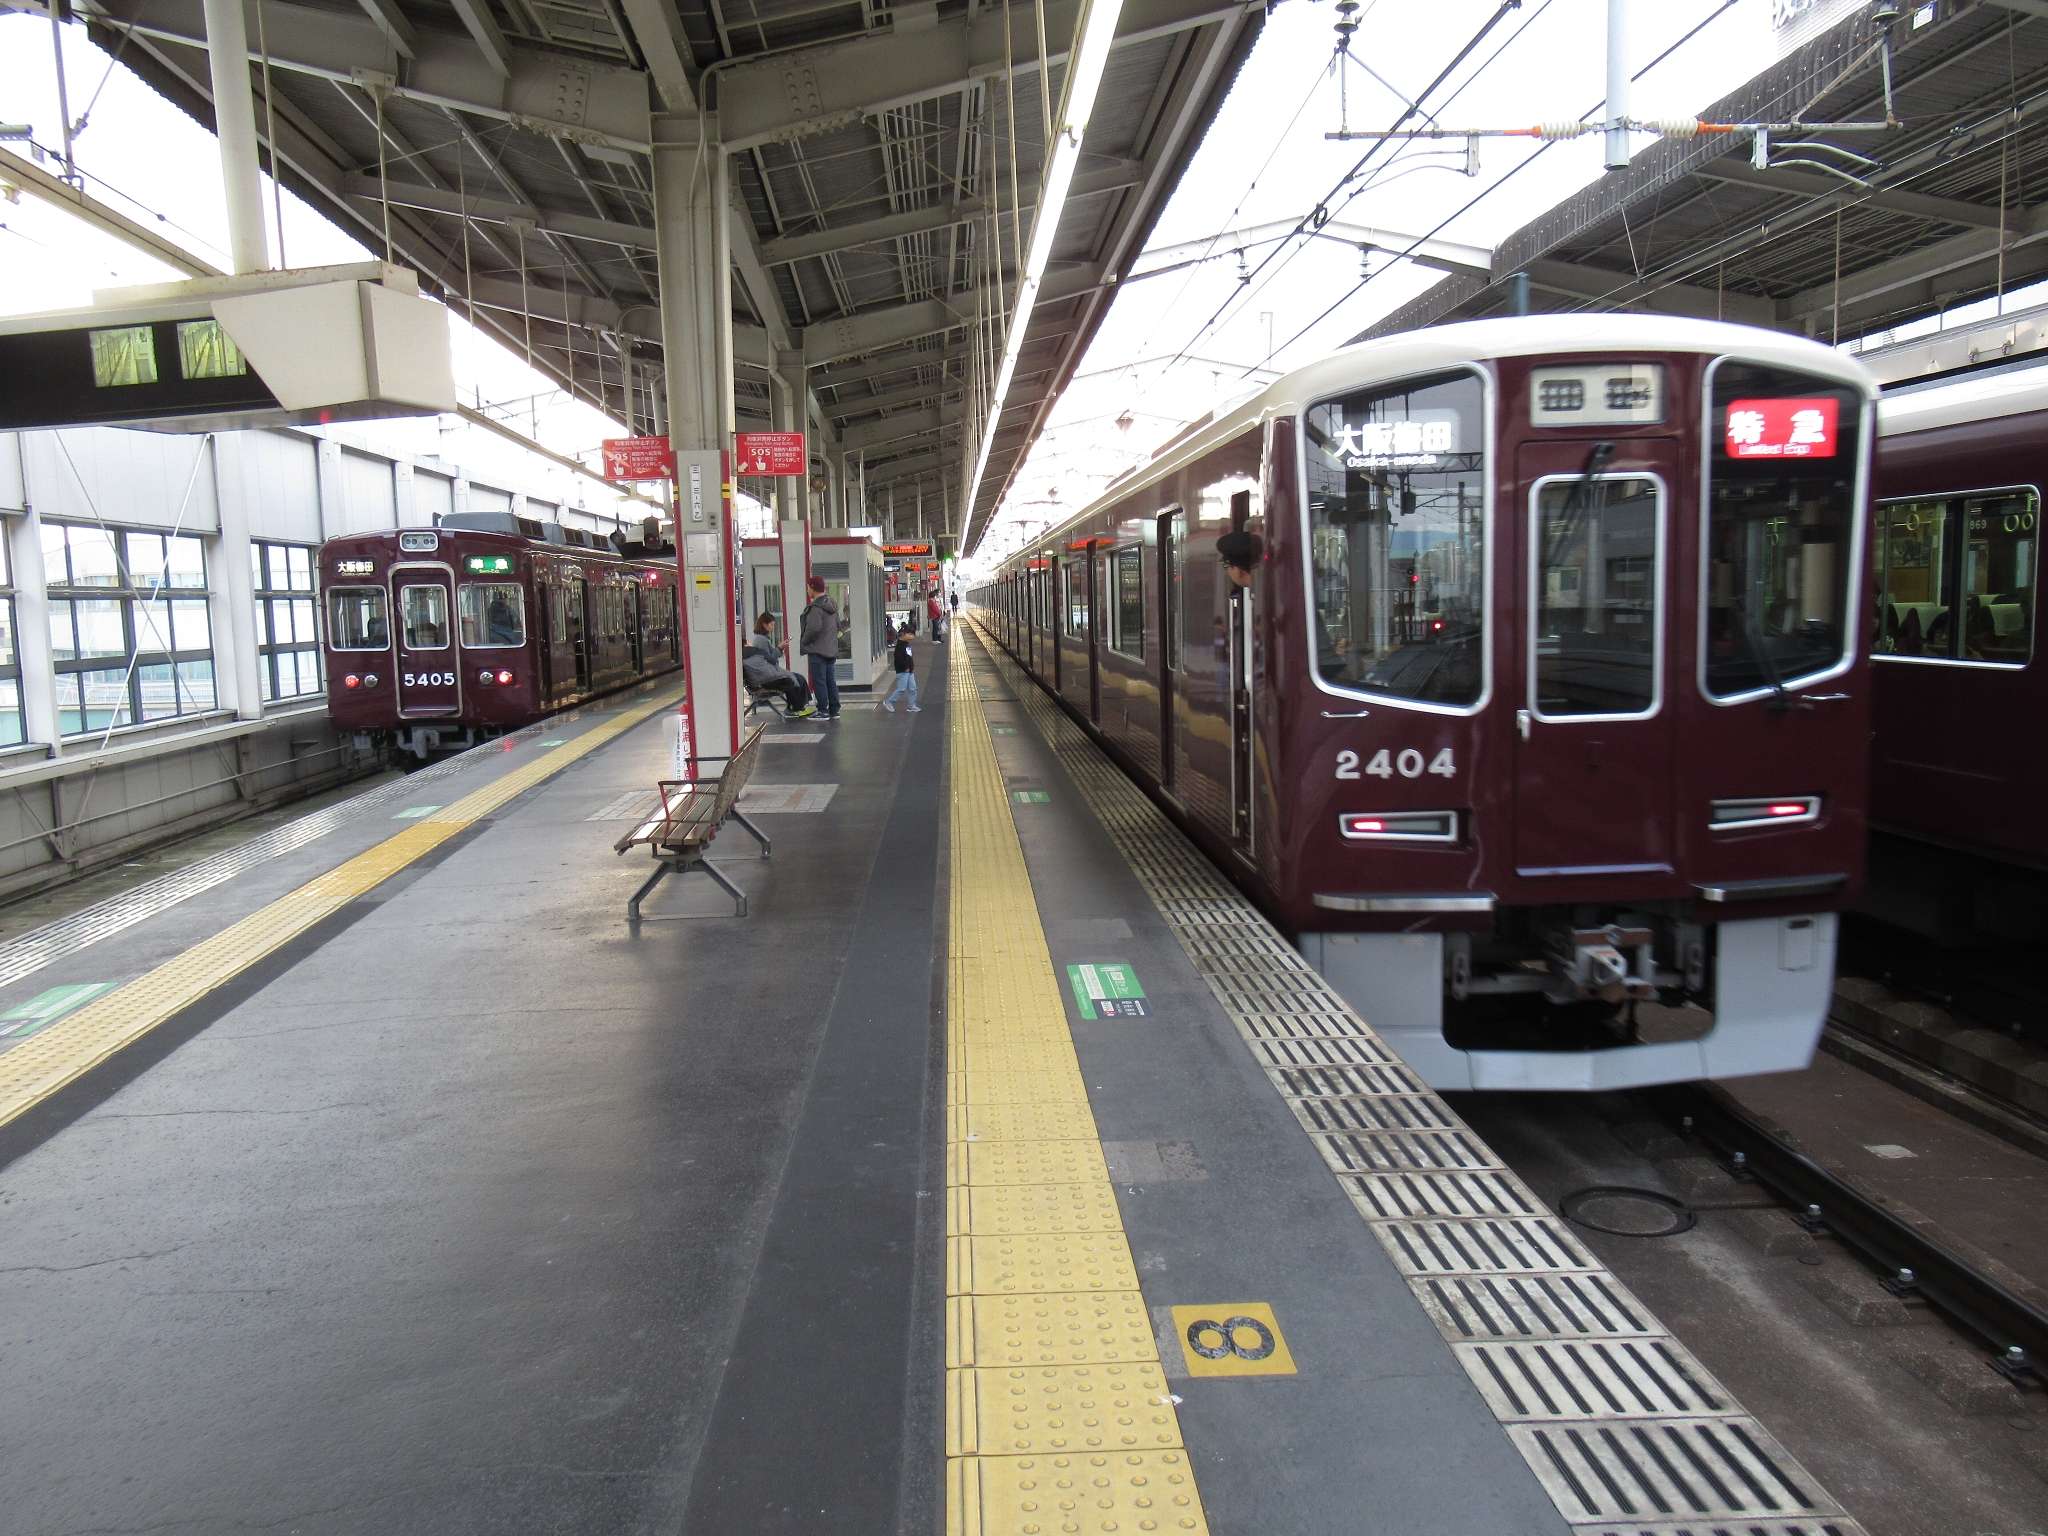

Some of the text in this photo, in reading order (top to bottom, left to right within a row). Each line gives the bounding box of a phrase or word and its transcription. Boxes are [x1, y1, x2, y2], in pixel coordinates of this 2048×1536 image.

[751, 448, 771, 456] SOS
[404, 672, 455, 687] 5405
[1335, 747, 1457, 779] 2404
[1186, 1316, 1276, 1361] 8
